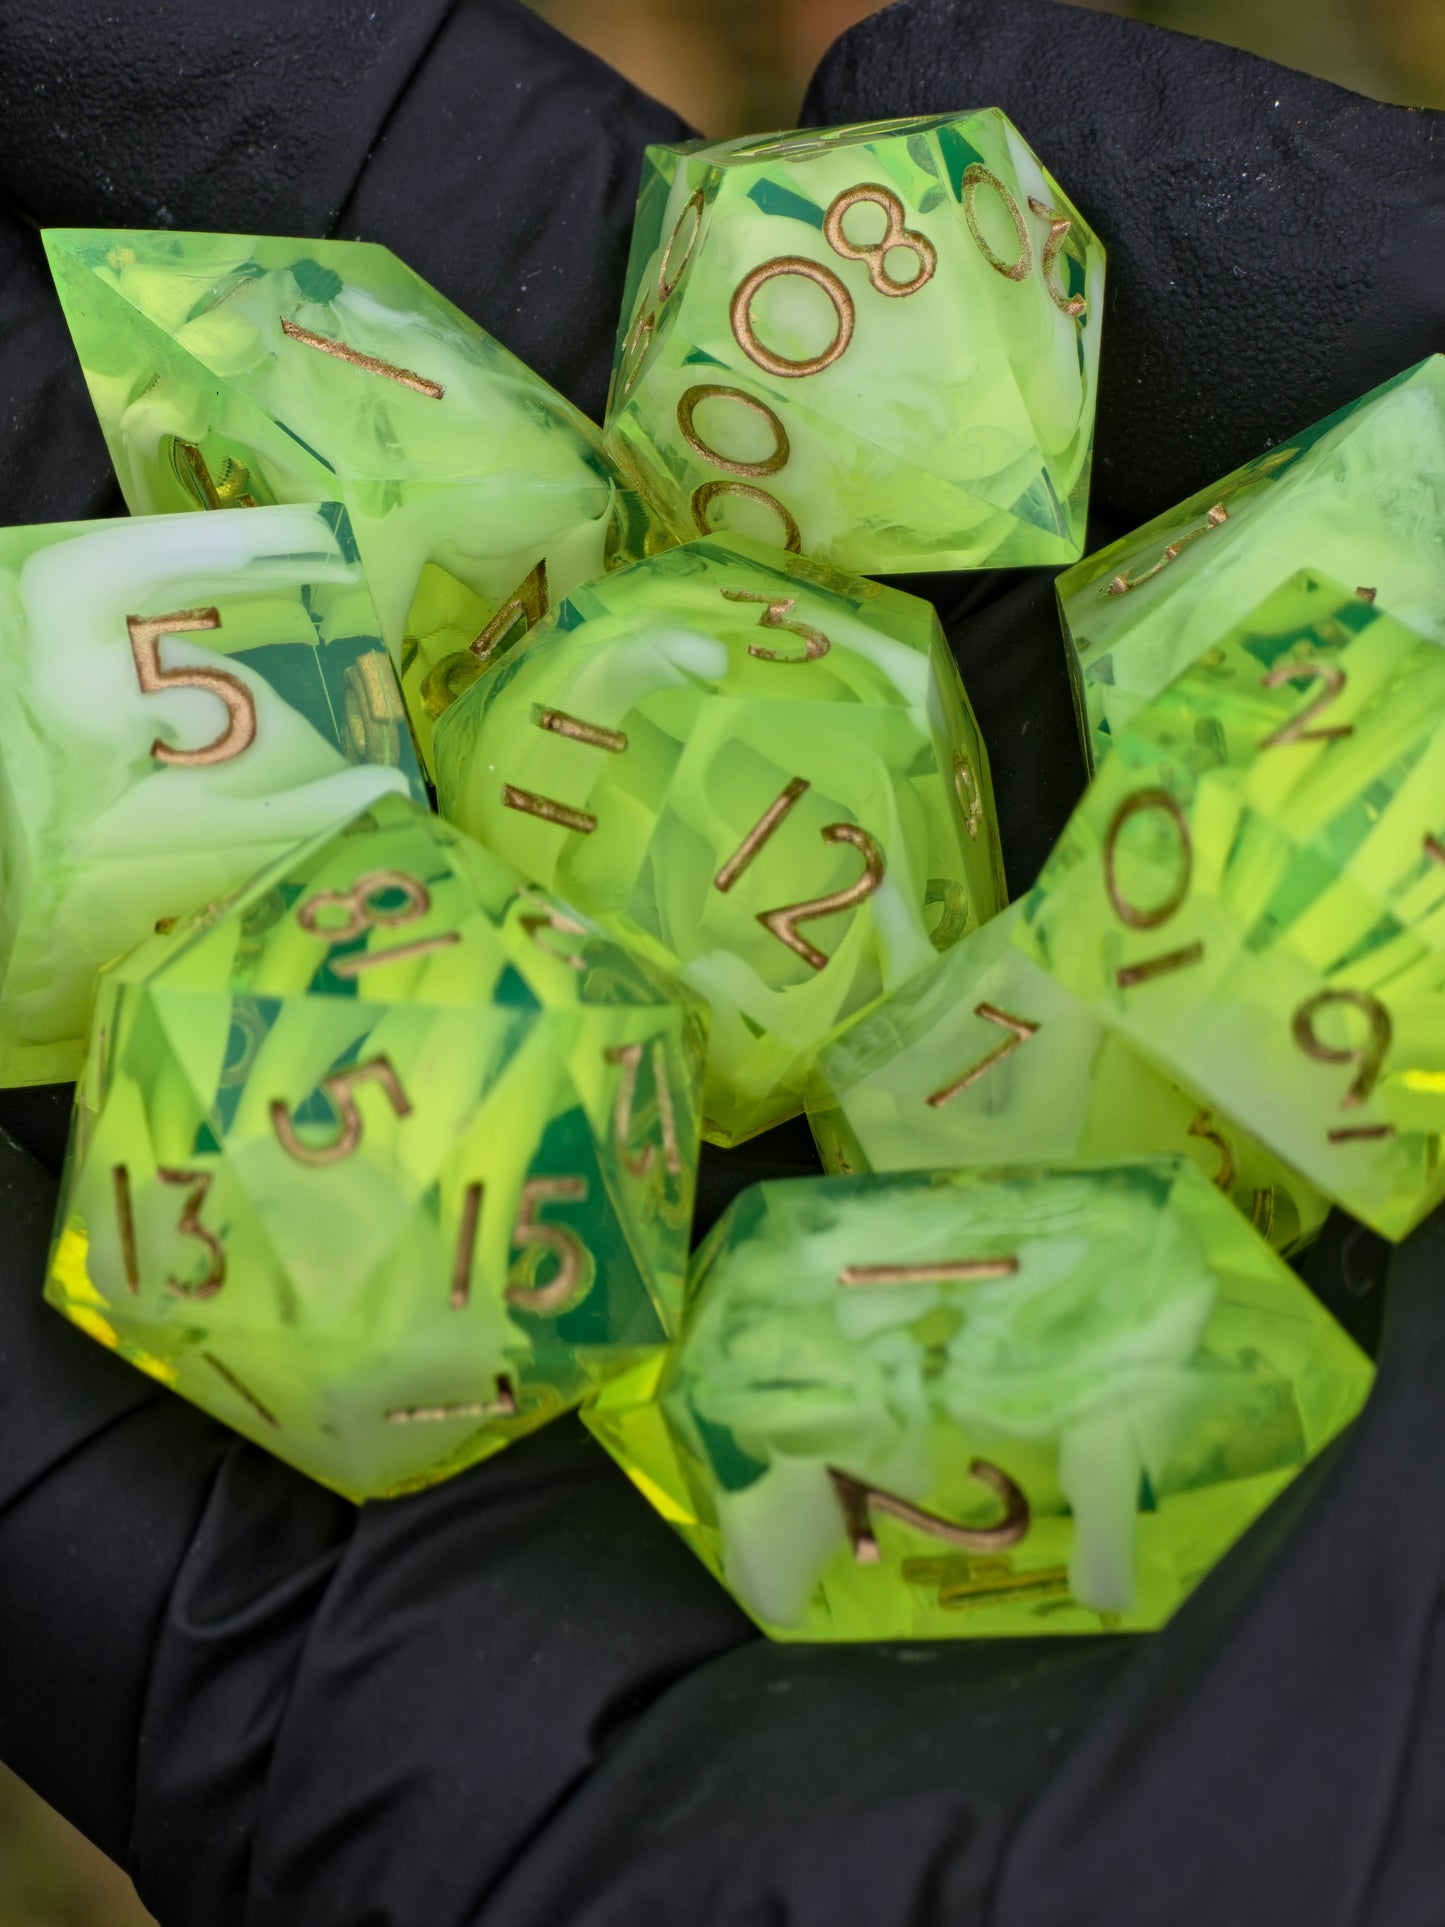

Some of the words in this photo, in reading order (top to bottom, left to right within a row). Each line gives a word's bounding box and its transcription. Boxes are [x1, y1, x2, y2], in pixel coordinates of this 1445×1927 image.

[125, 606, 257, 767] 5
[1258, 661, 1355, 751] 2
[713, 775, 885, 971] 12
[269, 1052, 412, 1167] 5
[925, 1002, 1041, 1109] 7
[112, 1163, 228, 1300] 13
[450, 1176, 592, 1312] 15
[826, 1455, 1032, 1564] 2
